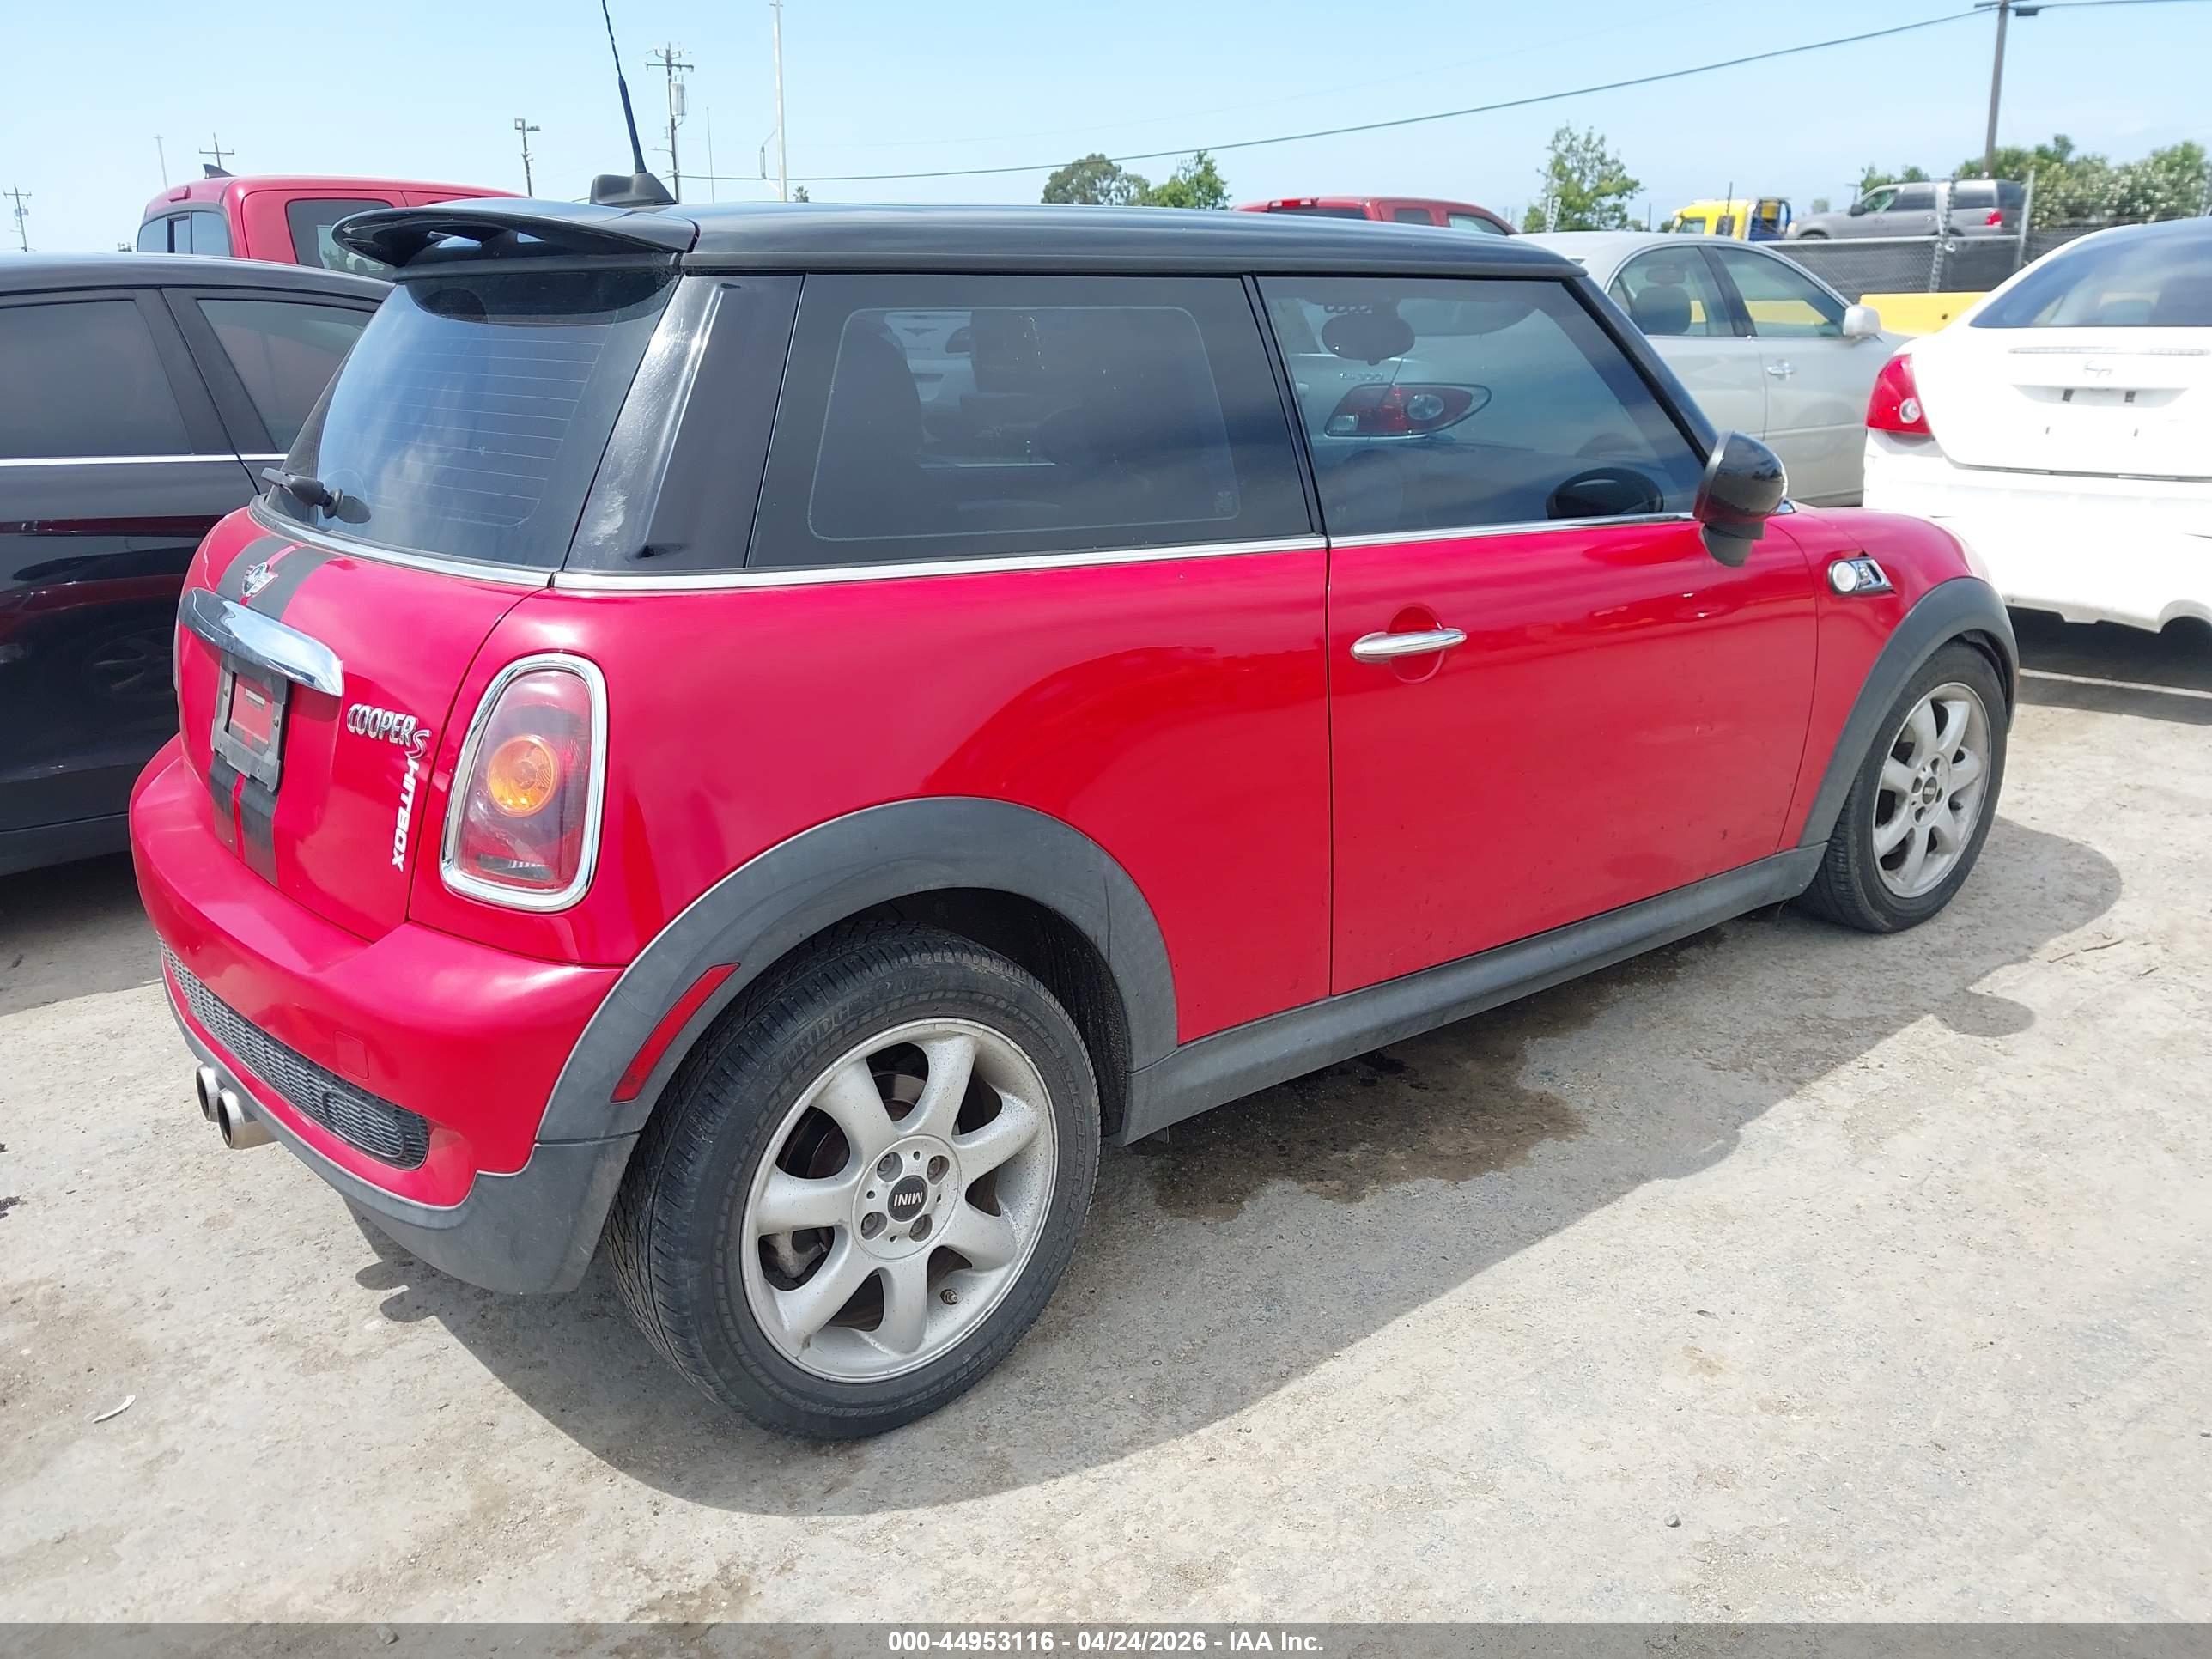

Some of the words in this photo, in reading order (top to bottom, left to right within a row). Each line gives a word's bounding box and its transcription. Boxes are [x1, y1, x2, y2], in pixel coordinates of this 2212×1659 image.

[347, 703, 418, 747] COOPER
[404, 729, 432, 759] S
[392, 757, 420, 872] HITBOX
[894, 1192, 923, 1206] MINI
